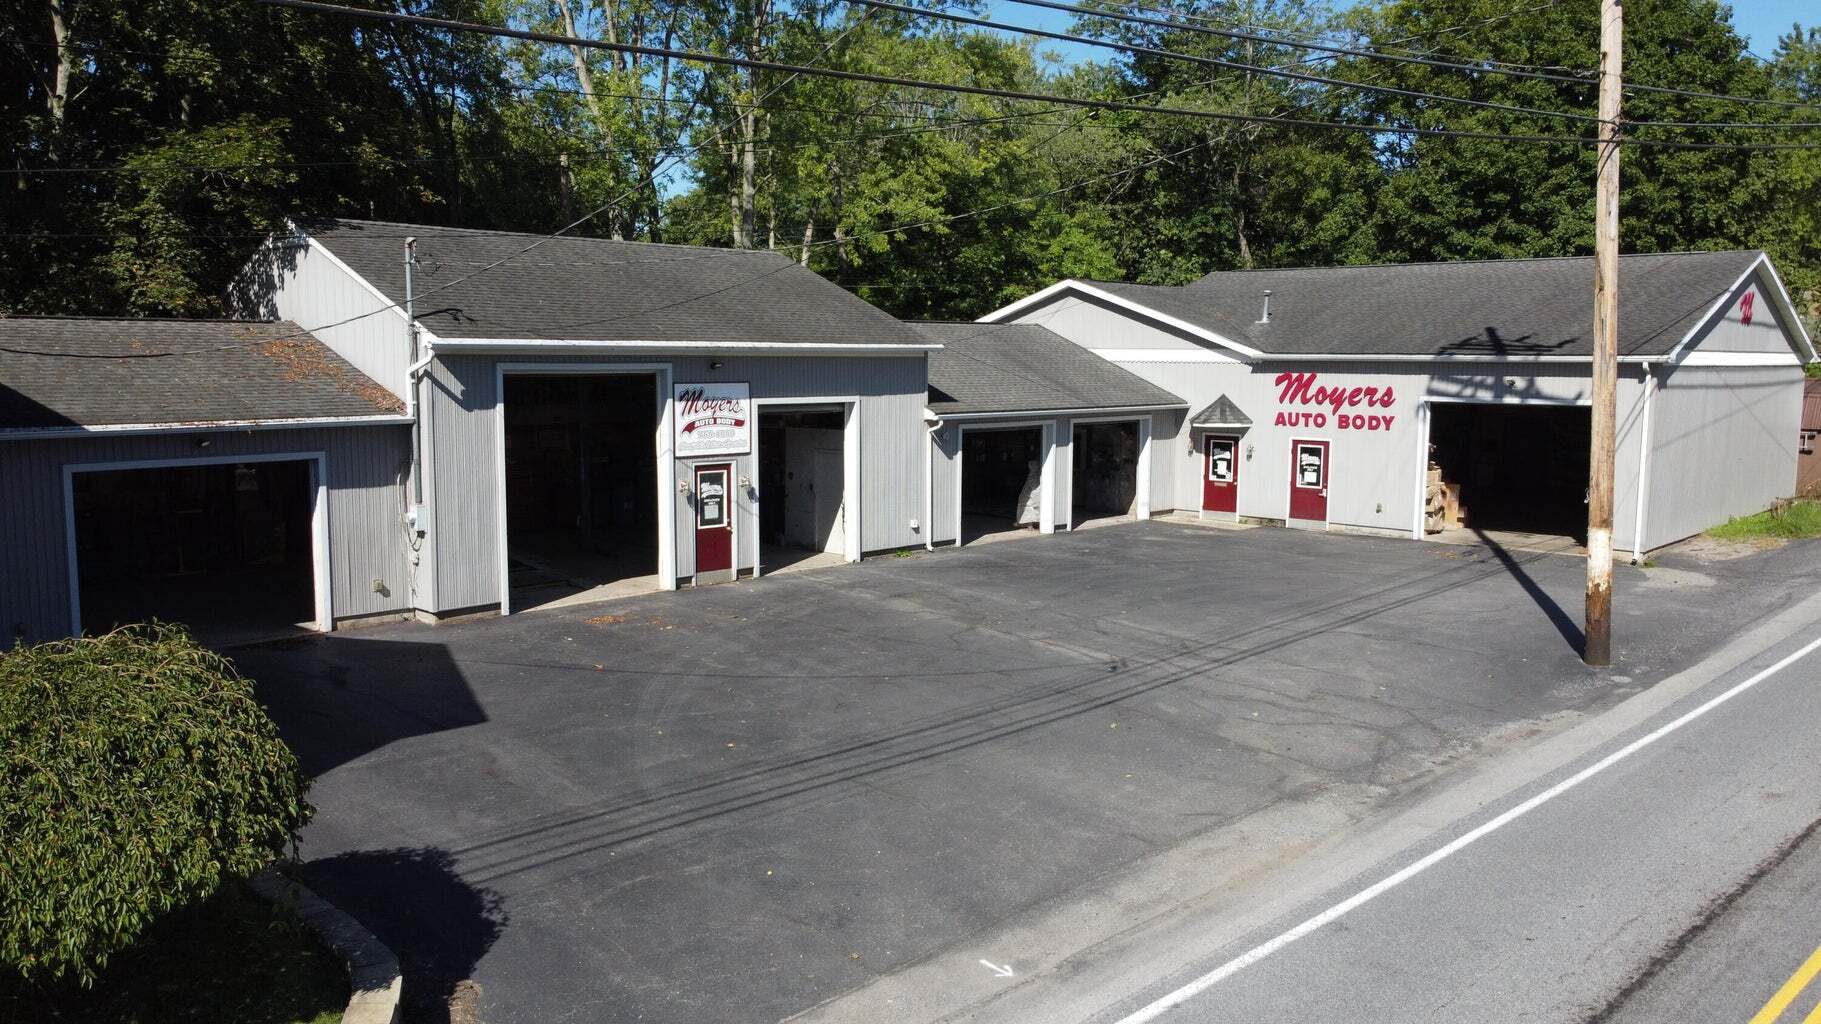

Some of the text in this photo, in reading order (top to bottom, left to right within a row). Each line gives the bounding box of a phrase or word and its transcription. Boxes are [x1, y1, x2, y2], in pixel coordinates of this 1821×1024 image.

[680, 387, 743, 417] Moyers
[1275, 371, 1396, 416] Moyers
[694, 418, 736, 428] AUTO BODY
[1275, 412, 1395, 431] AUTO BODY
